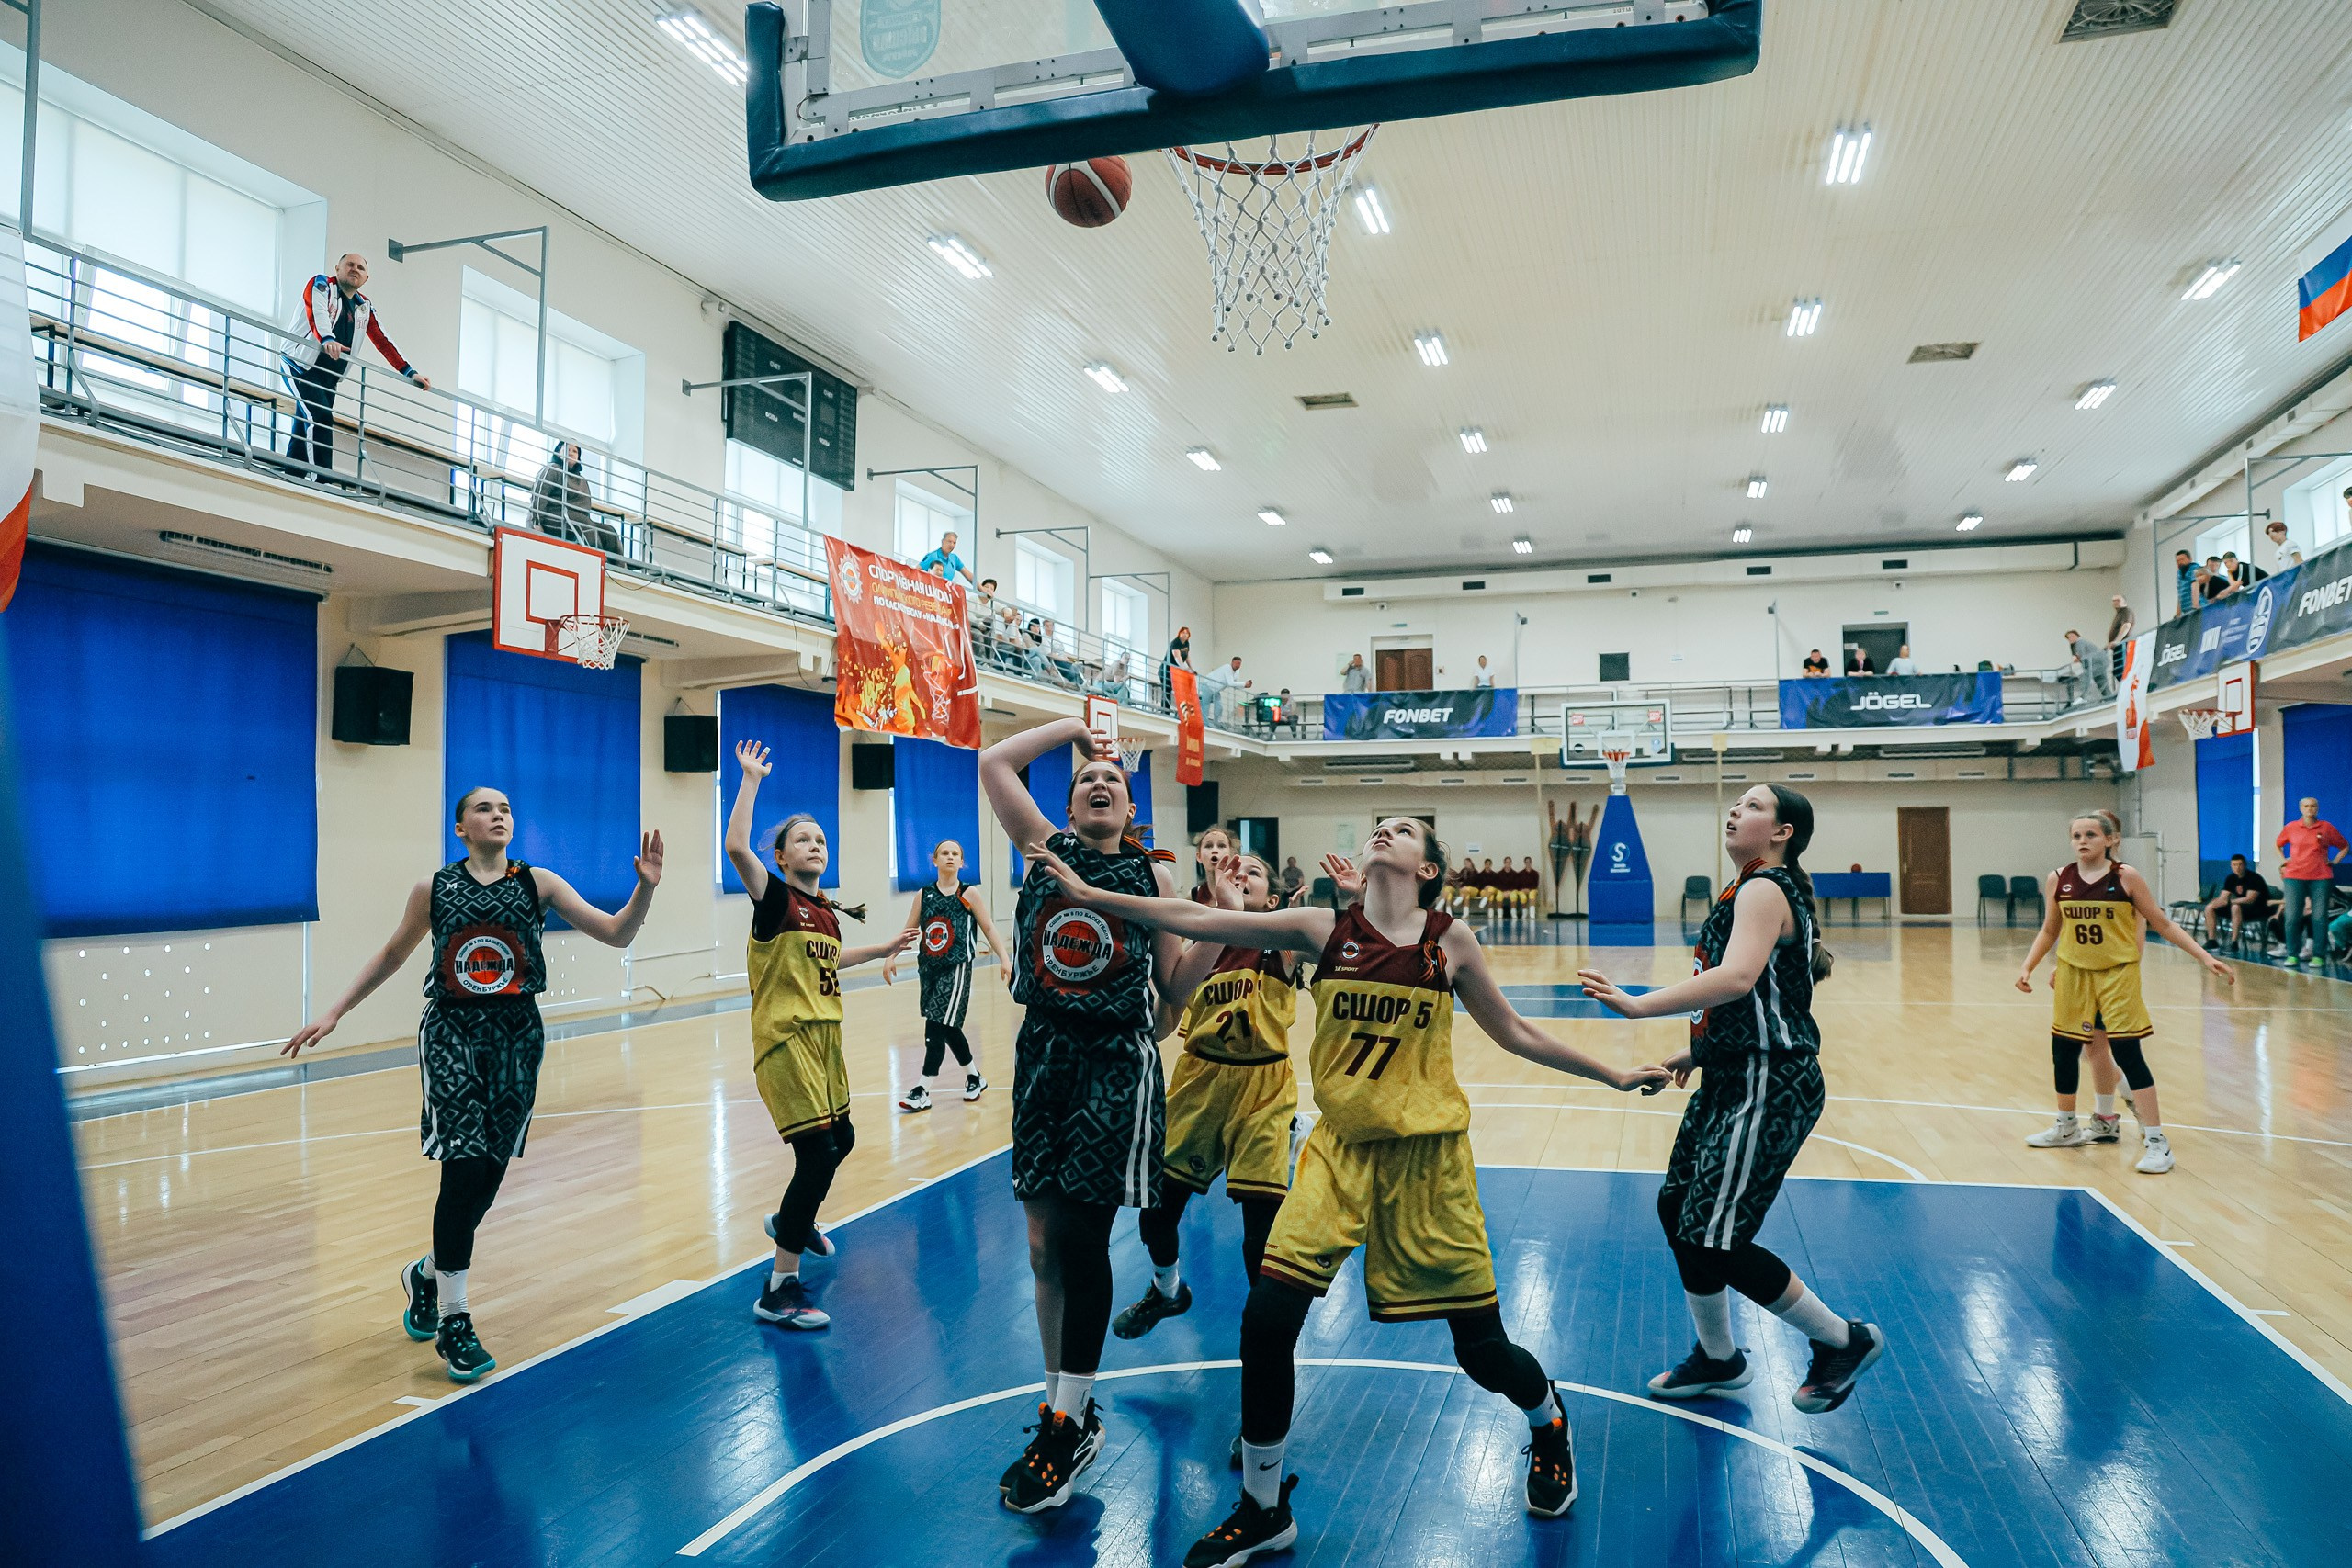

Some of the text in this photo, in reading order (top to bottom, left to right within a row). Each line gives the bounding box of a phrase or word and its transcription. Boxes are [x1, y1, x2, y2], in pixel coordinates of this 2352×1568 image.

[868, 563, 925, 596] СПОРИВНАЯ
[1382, 707, 1453, 725] FONBET
[1849, 691, 1933, 712] JÖGEL
[2063, 907, 2115, 919] СШОР 5
[1043, 929, 1112, 961] НАДЕЖДА
[2075, 923, 2104, 945] 69
[1045, 954, 1100, 978] ОРЕНБУРЖЬЕ
[1204, 977, 1254, 1007] СШОР
[1332, 991, 1434, 1030] СШОР 5
[1215, 1010, 1252, 1045] 21
[1344, 1032, 1402, 1081] 77
